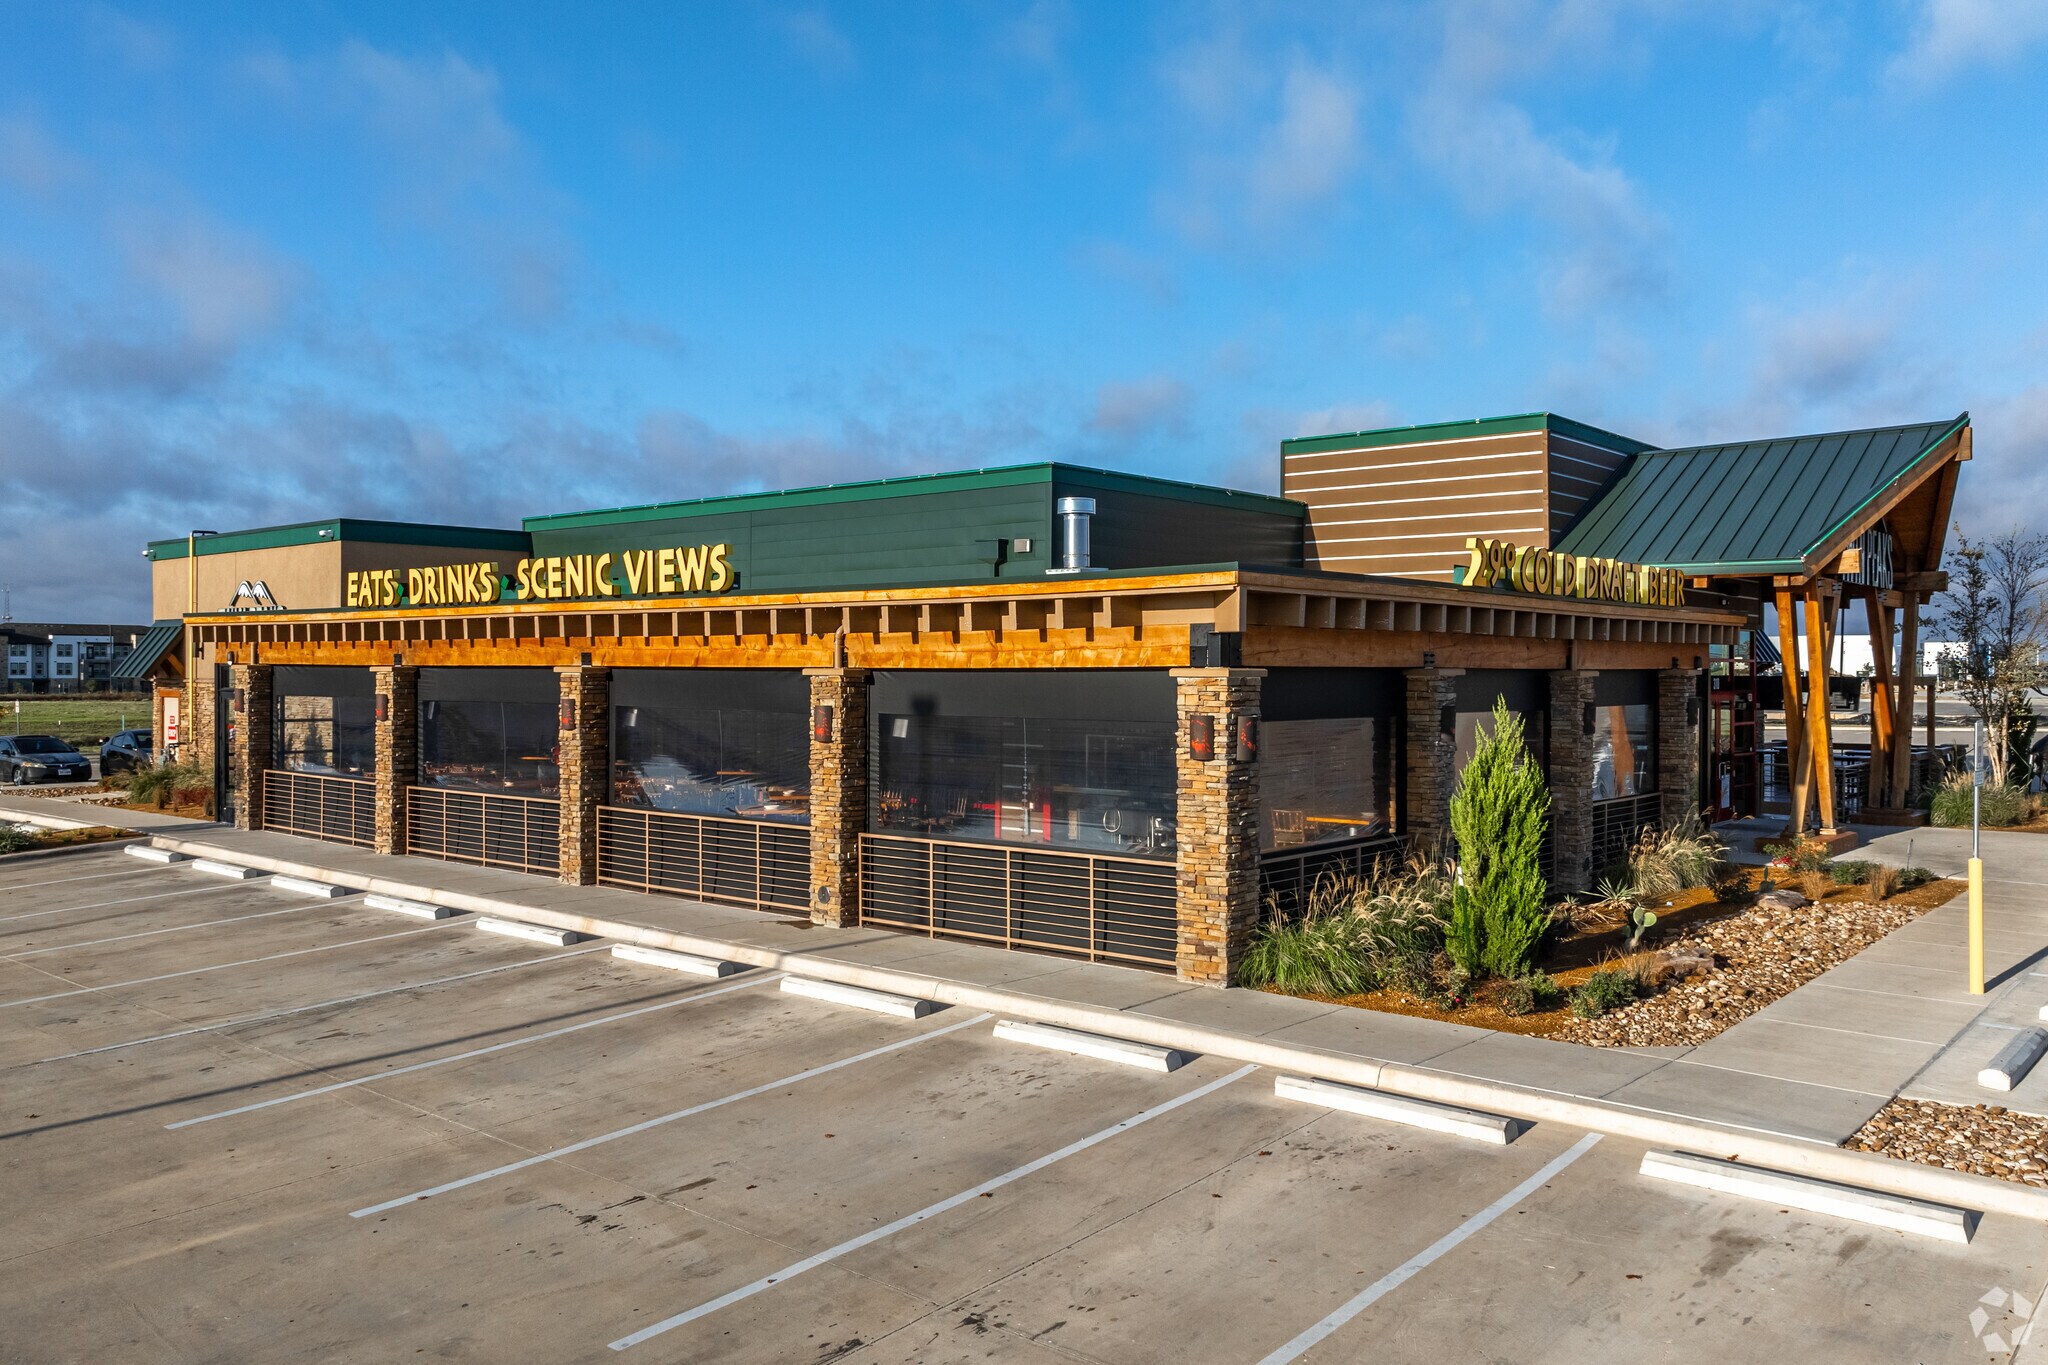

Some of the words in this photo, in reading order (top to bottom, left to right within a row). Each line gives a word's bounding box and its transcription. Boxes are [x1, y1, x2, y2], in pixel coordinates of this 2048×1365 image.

[347, 569, 397, 608] EATS
[408, 562, 495, 605] DRINKS
[517, 552, 616, 600] SCENIC
[622, 543, 730, 593] VIEWS
[1519, 546, 1576, 596] COLD
[1584, 557, 1643, 603] DRAFT
[1649, 565, 1685, 607] BEER
[1867, 529, 1893, 590] PEAKS
